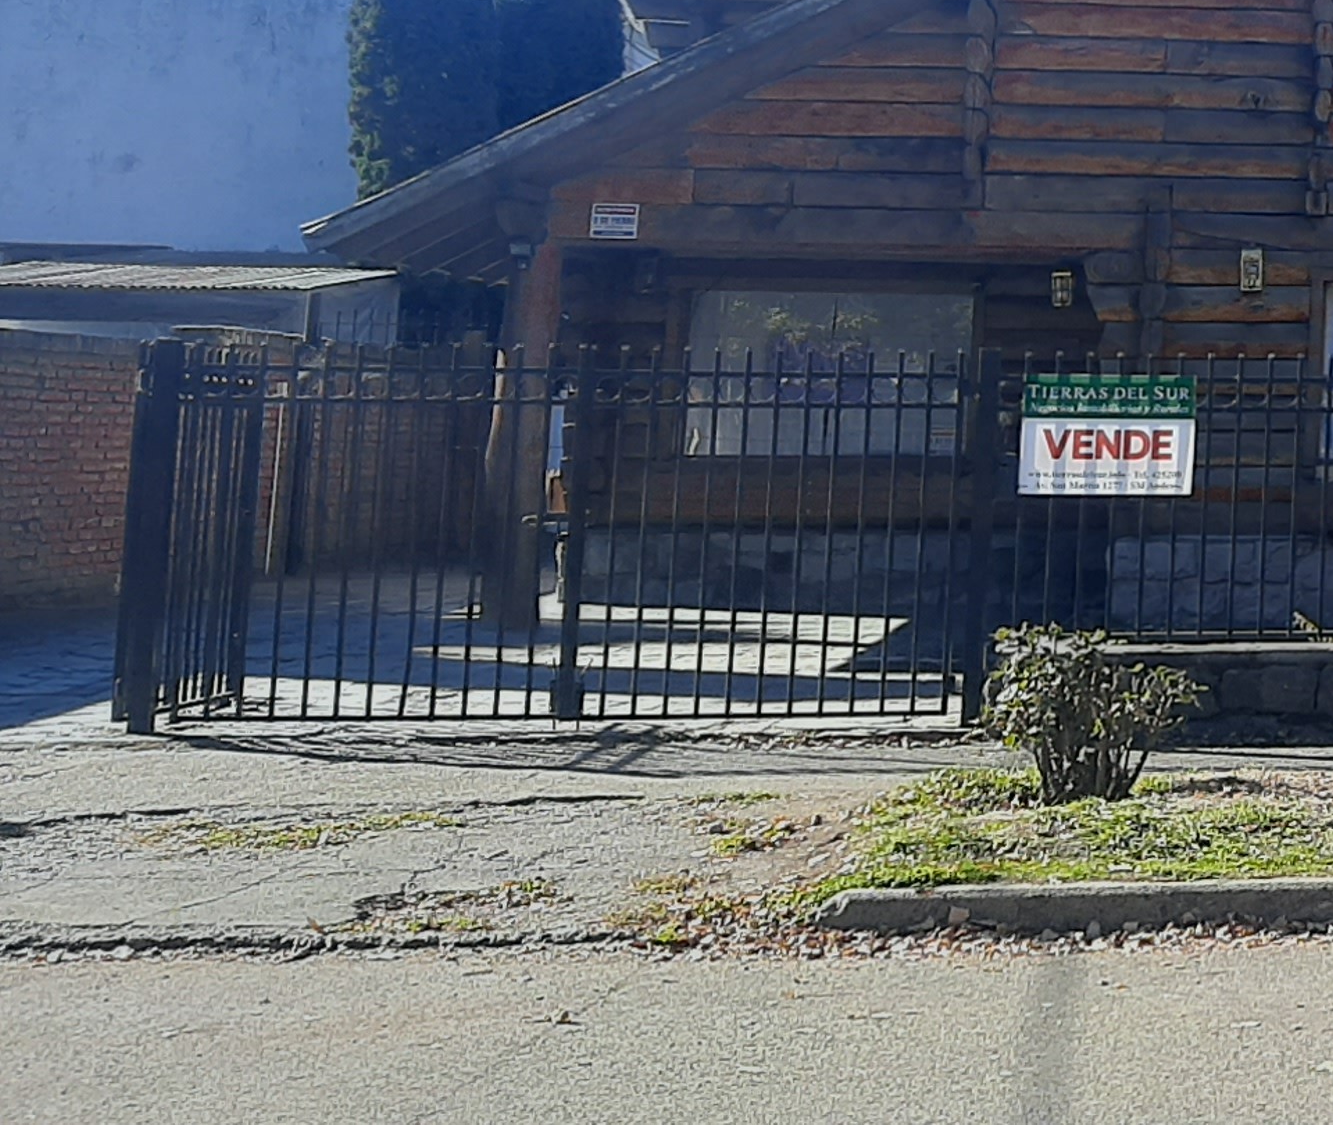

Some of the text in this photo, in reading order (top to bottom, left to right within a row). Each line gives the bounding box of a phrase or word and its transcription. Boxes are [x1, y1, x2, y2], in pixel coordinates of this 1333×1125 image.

[1028, 384, 1190, 400] TIERRAS DEL SUR
[1043, 429, 1173, 460] VENDE
